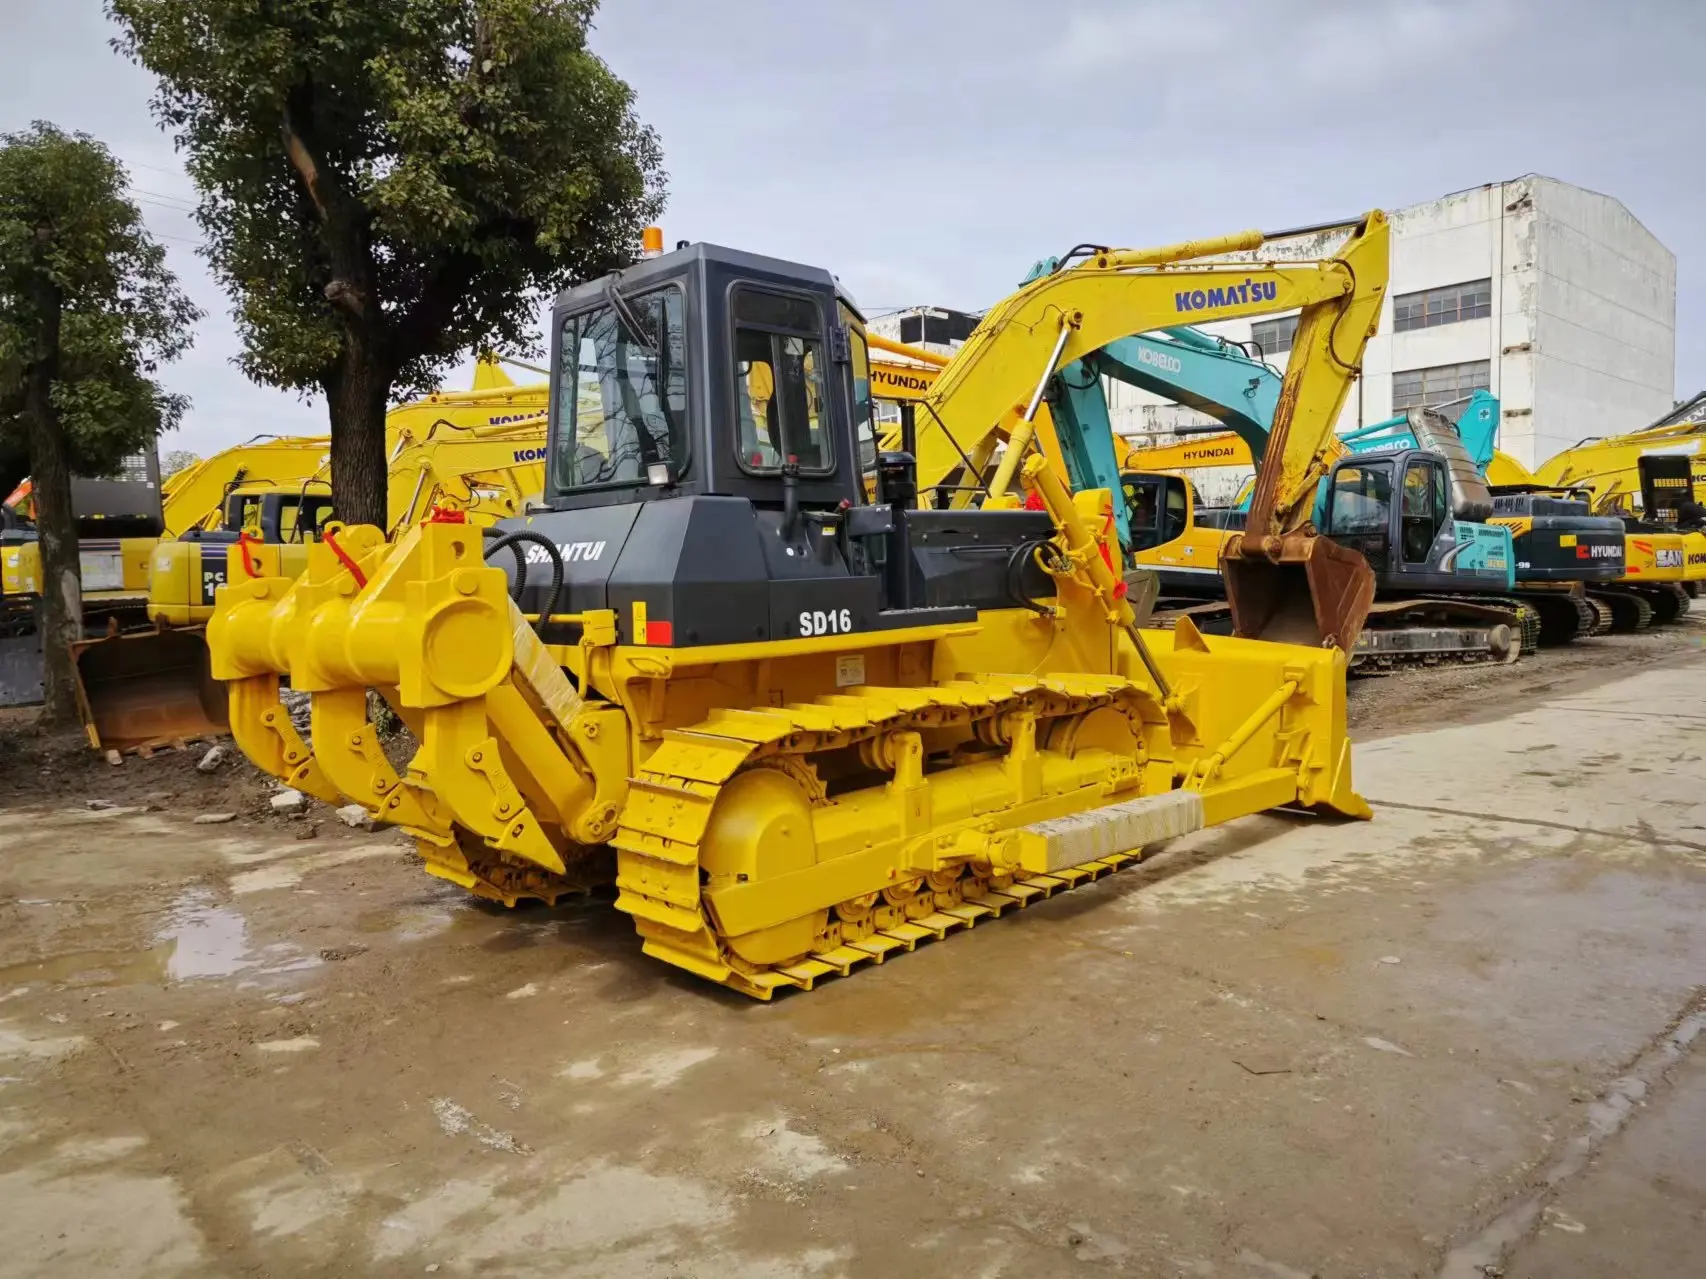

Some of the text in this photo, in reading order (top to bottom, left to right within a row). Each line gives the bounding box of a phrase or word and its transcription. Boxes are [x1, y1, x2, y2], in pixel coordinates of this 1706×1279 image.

[1175, 278, 1276, 312] KOMATSU
[1138, 345, 1181, 373] KOBELCO
[1183, 448, 1234, 460] HYUNDAI
[1590, 545, 1623, 558] HYUNDAI
[203, 571, 224, 582] PC
[203, 582, 229, 597] 1
[799, 608, 852, 637] SD16
